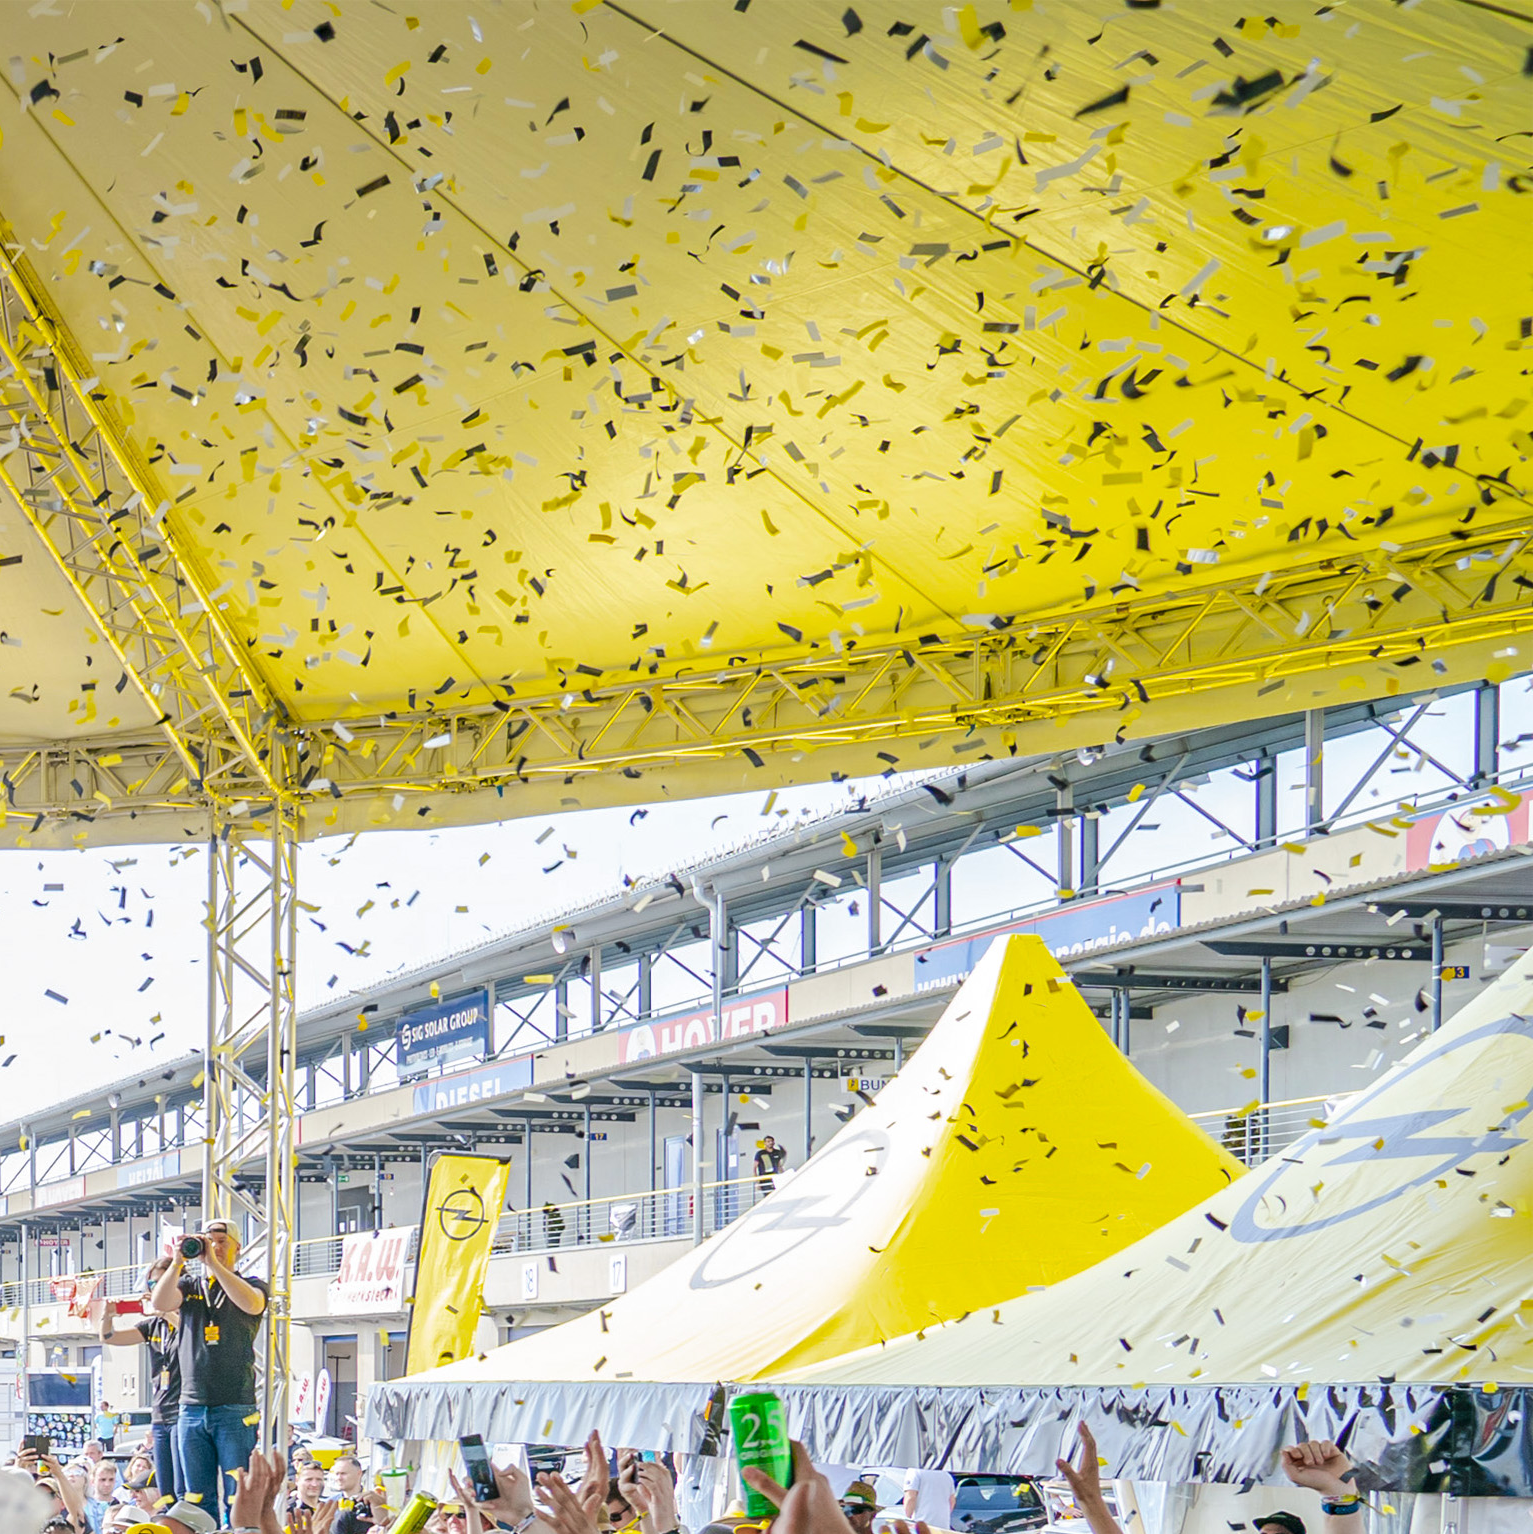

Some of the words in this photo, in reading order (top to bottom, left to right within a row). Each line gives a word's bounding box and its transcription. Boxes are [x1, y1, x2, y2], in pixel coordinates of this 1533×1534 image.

[411, 1029, 423, 1043] SIG
[424, 1019, 449, 1039] SOLAR
[449, 1007, 478, 1031] GROUP
[337, 1238, 403, 1285] K.A.W.
[612, 1261, 622, 1287] 17
